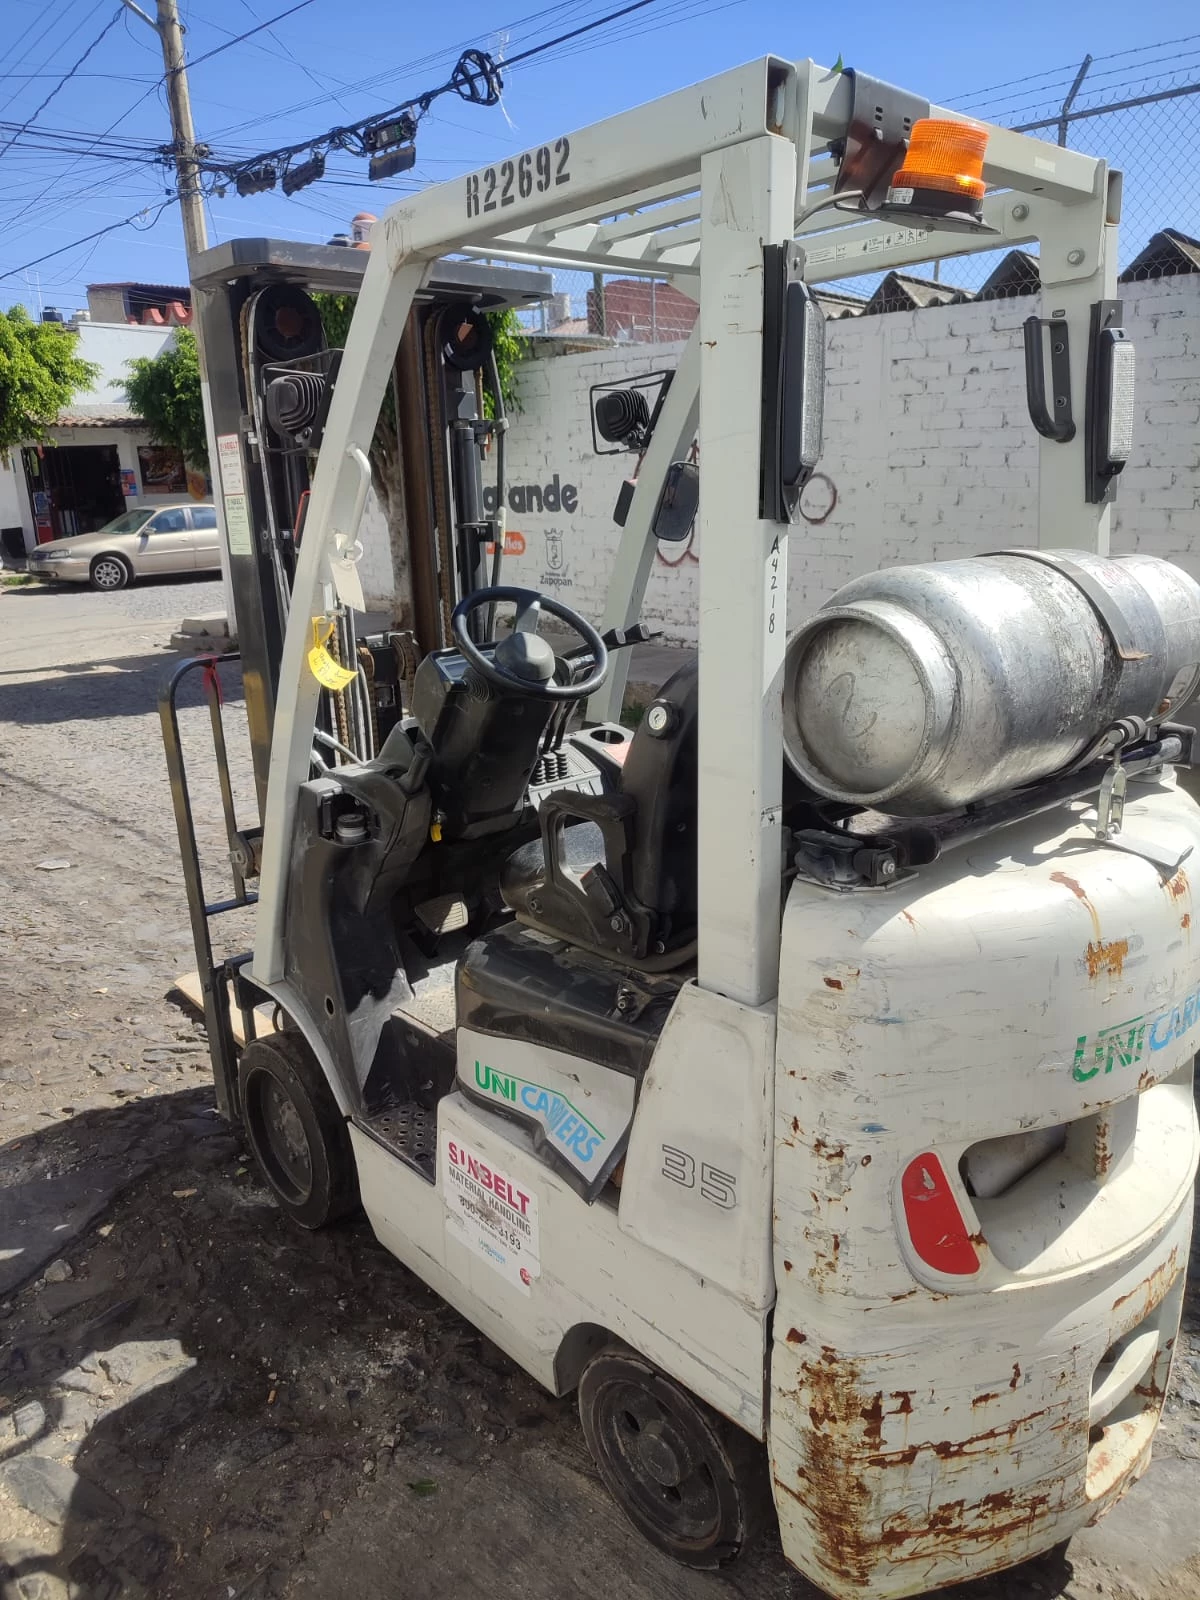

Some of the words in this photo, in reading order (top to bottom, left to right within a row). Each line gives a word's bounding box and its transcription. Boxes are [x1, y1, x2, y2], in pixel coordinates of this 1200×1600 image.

[466, 137, 570, 218] R22692
[483, 474, 578, 520] gande
[448, 1165, 485, 1202] MATERIAL
[489, 1195, 532, 1237] HANDLING
[662, 1144, 737, 1210] 35
